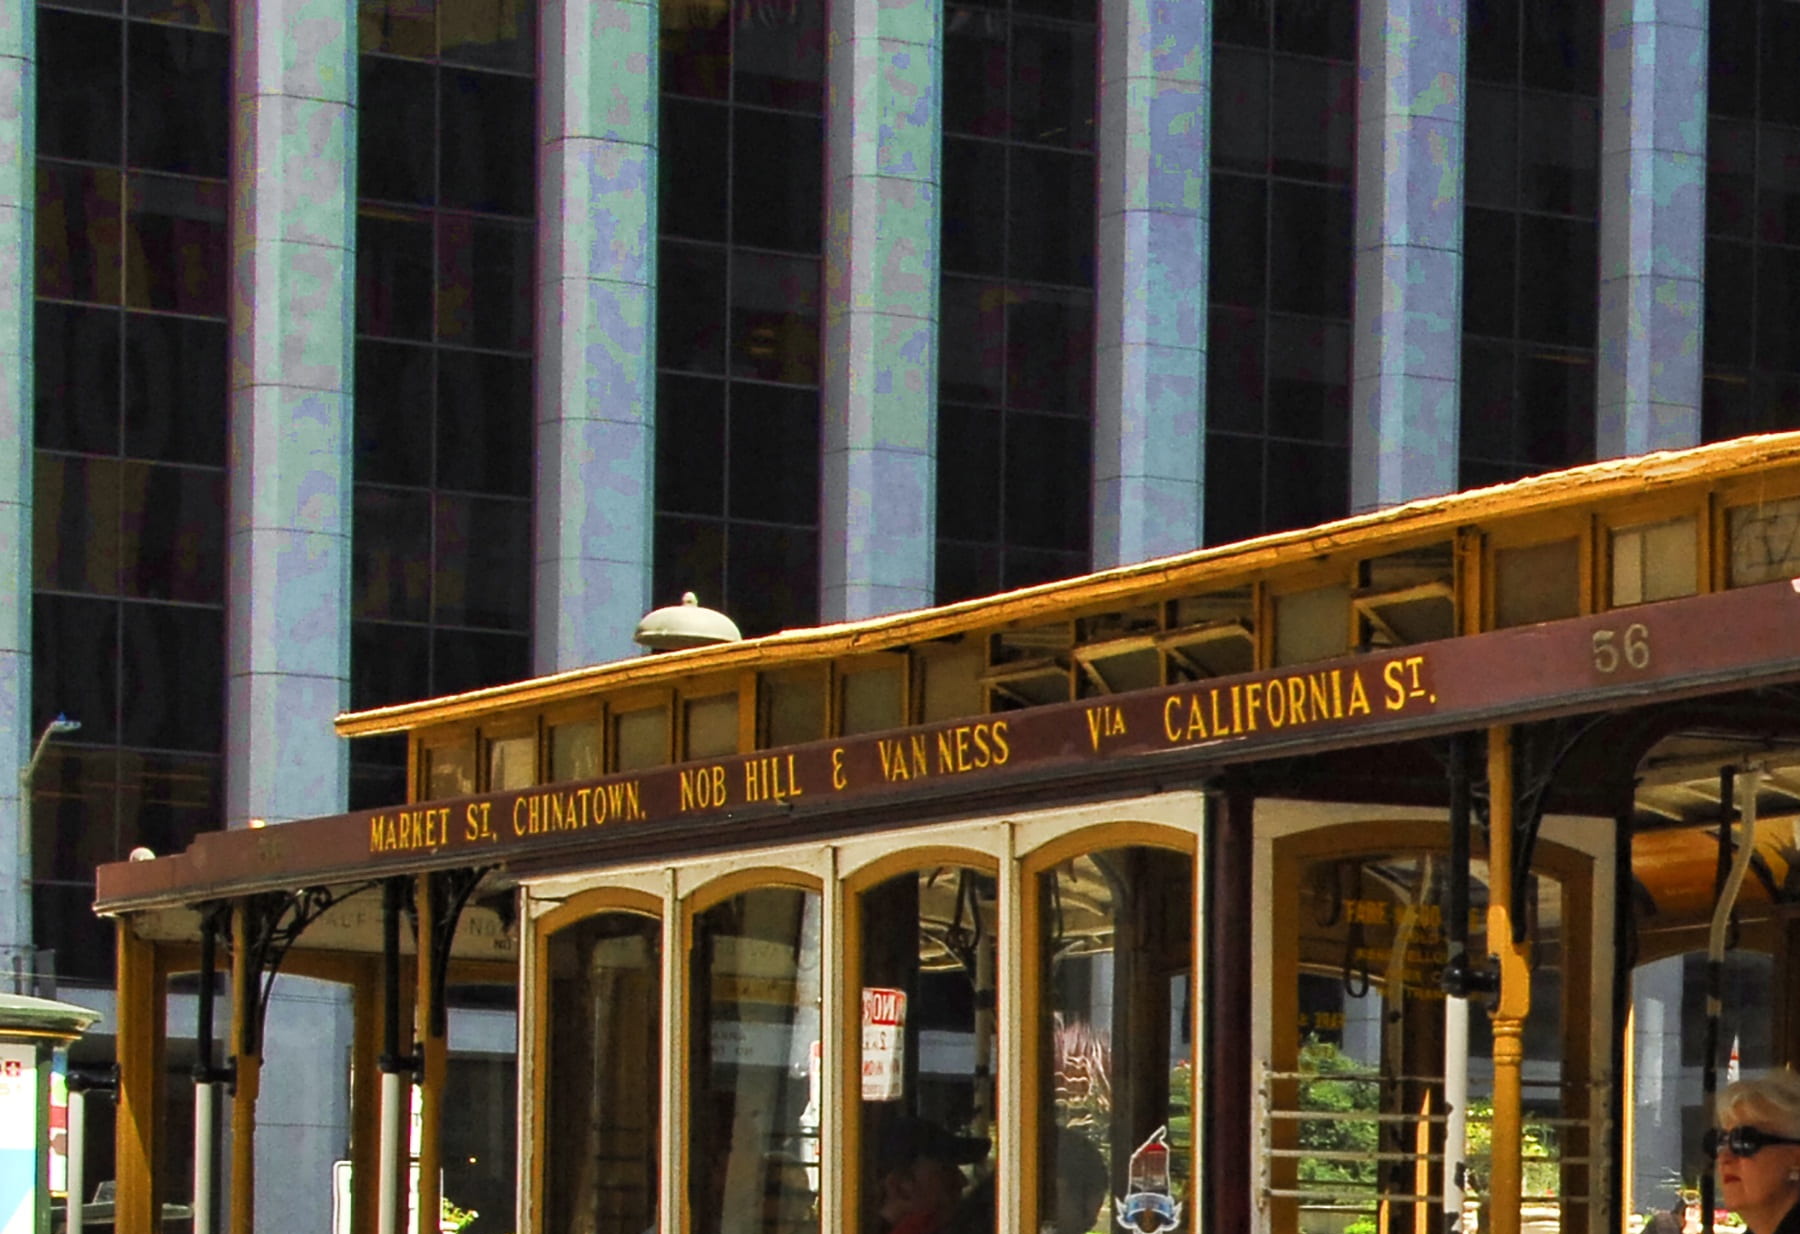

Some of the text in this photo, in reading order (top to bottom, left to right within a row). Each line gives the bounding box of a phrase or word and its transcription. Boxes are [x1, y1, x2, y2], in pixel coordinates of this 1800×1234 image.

[1592, 623, 1650, 674] 56
[370, 808, 450, 852] MARKET
[680, 765, 726, 811] NOB
[745, 754, 803, 802] HILL
[877, 736, 928, 783] VAN
[938, 721, 1010, 772] NESS
[1163, 673, 1371, 743] CALIFORNIA
